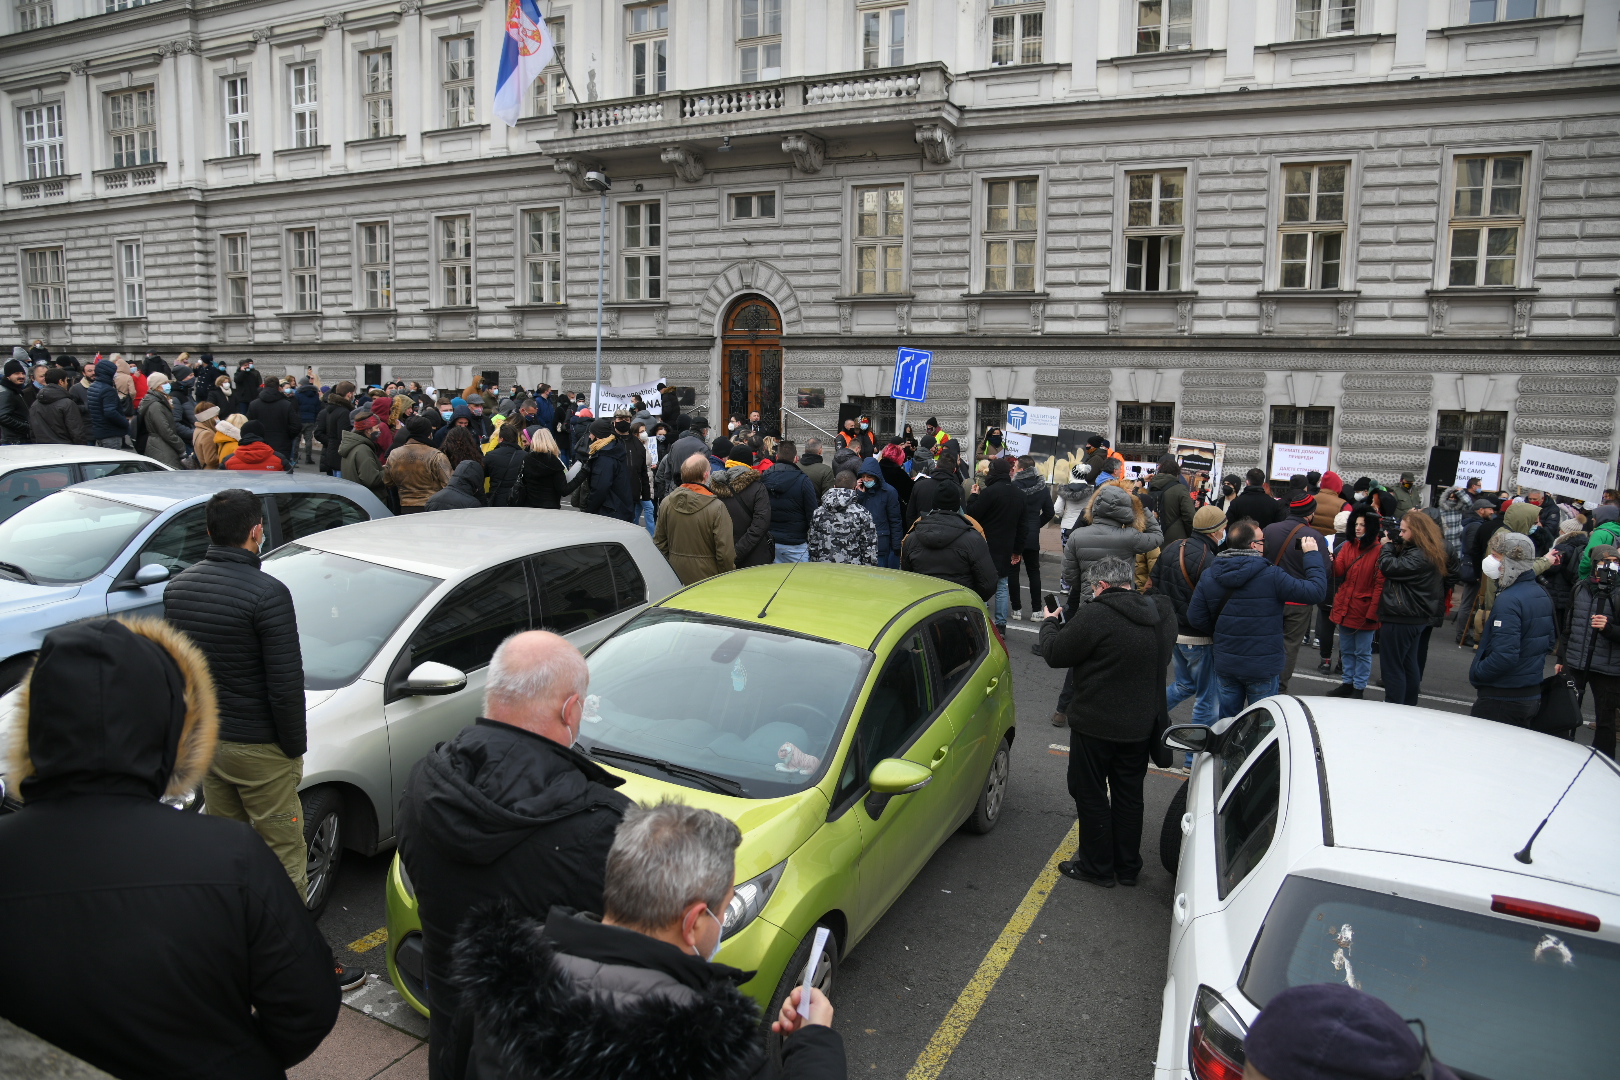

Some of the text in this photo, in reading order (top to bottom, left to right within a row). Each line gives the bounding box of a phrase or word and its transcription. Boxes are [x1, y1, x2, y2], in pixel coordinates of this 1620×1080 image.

[1520, 466, 1531, 474] BEZ
[1555, 474, 1570, 482] SMO
[1526, 459, 1538, 467] OVO
[1546, 463, 1576, 476] RADNIČKI
